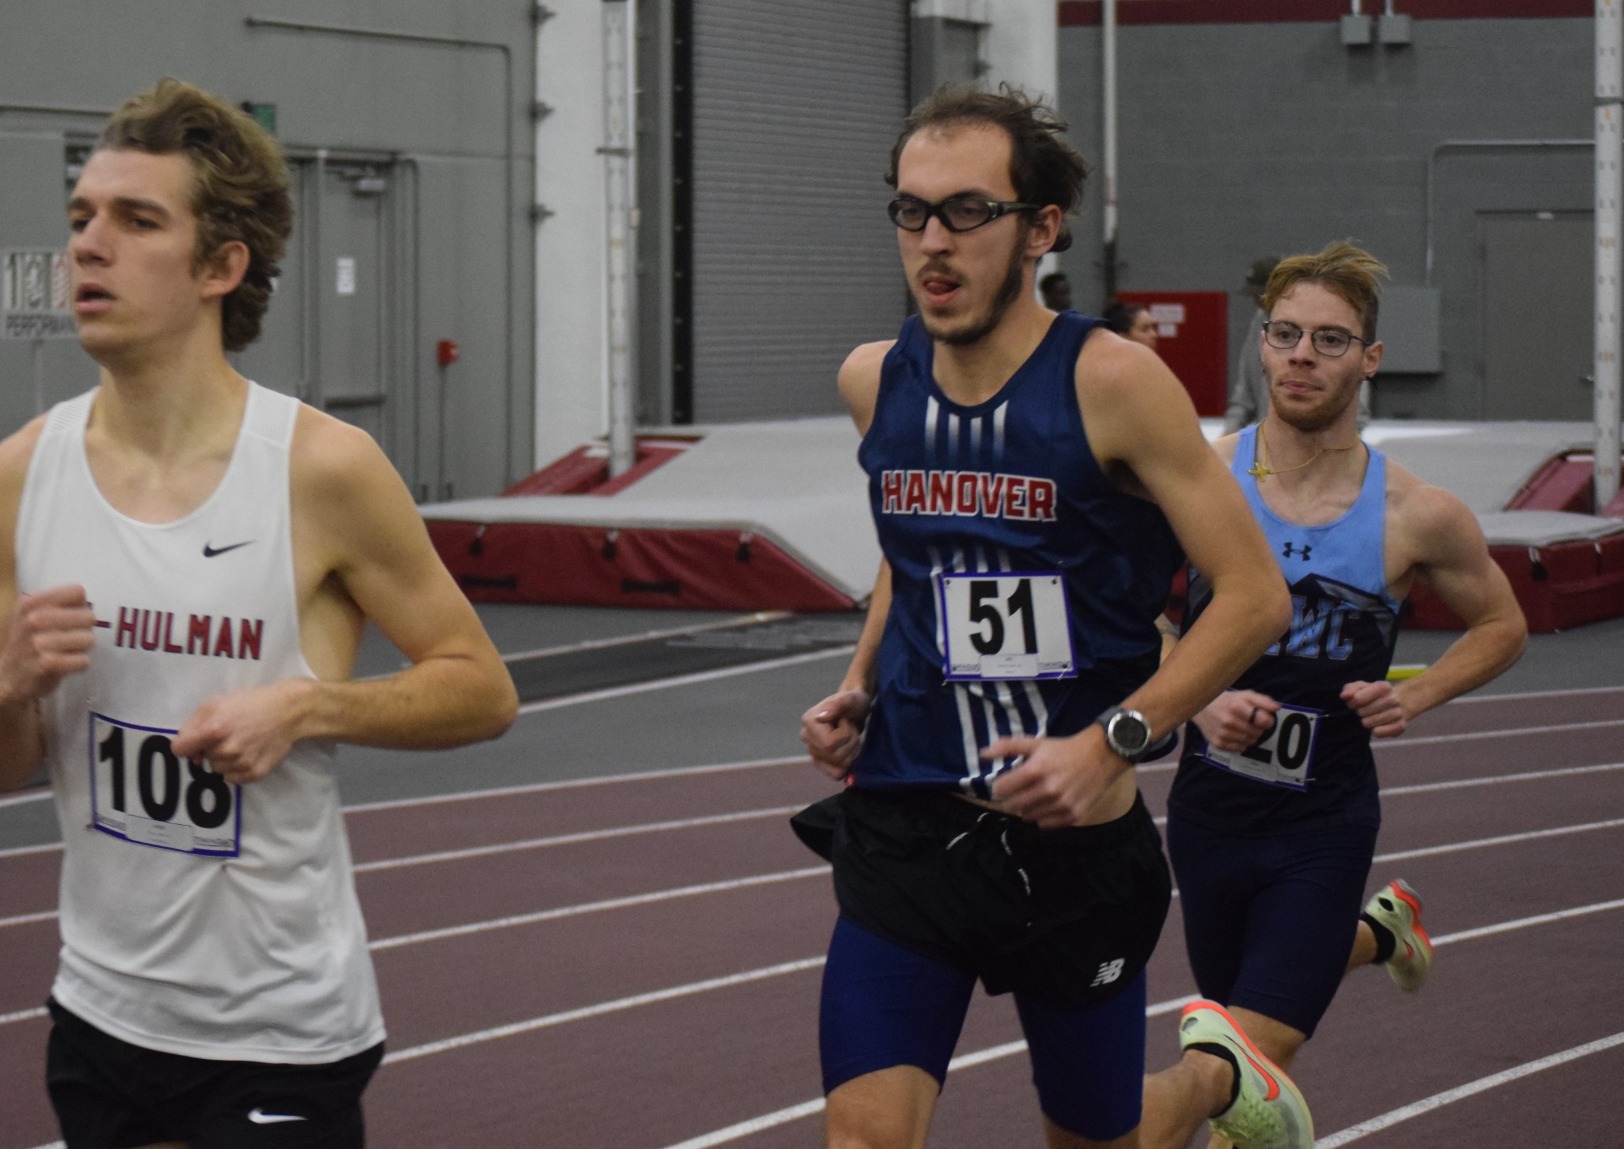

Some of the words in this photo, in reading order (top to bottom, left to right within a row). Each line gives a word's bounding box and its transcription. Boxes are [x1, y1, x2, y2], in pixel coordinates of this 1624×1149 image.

[881, 470, 1057, 521] HANOVER
[969, 578, 1038, 655] 51
[1264, 595, 1360, 661] WC
[99, 726, 231, 829] 108
